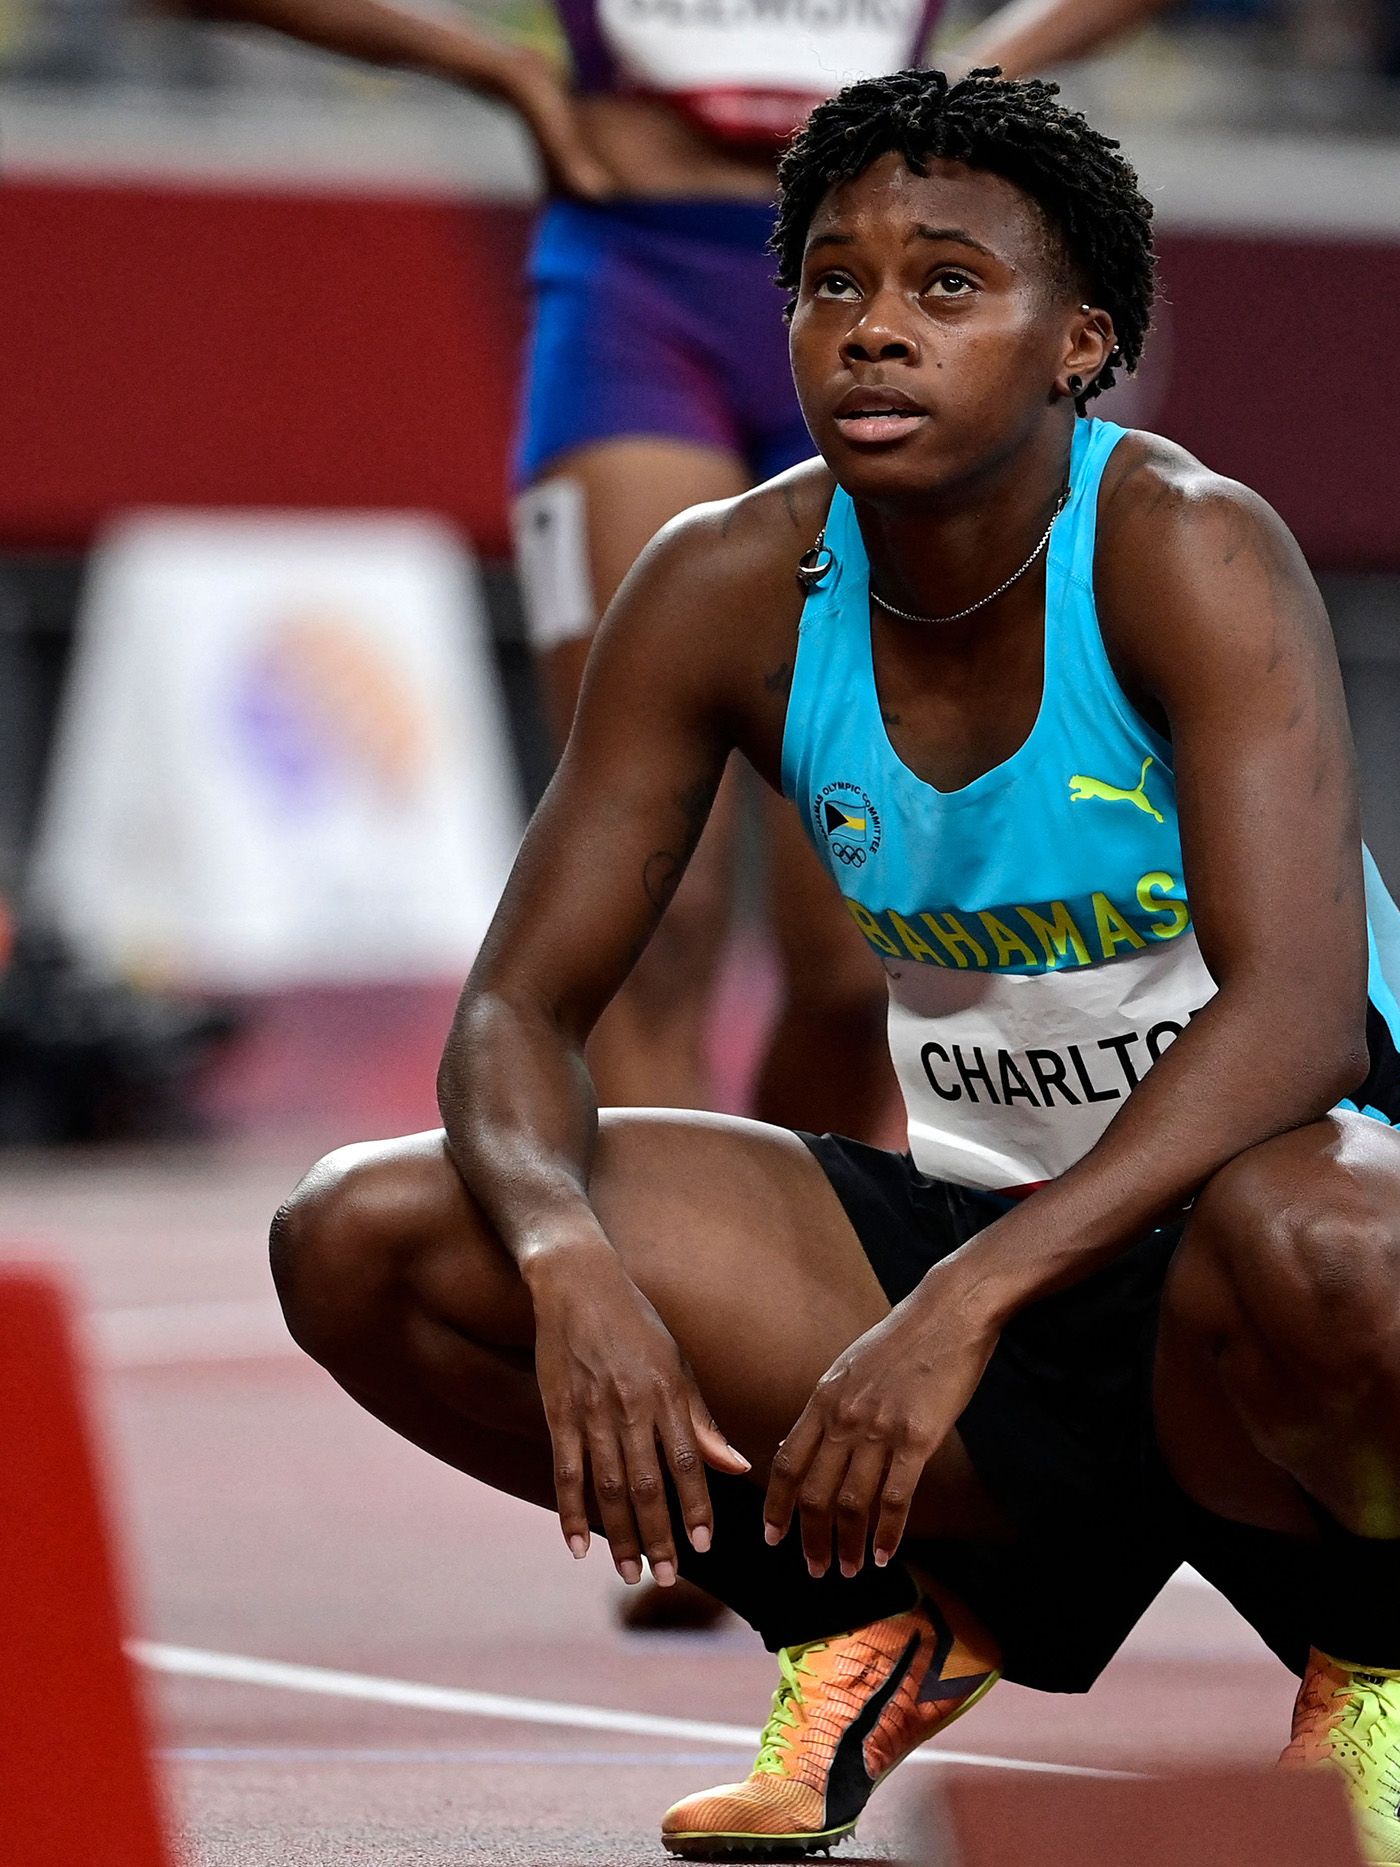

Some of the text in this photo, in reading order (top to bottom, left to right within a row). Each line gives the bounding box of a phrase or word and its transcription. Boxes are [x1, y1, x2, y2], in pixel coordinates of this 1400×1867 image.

[822, 781, 862, 796] OLYMPIC
[862, 793, 881, 854] COMMITTEE
[847, 871, 1189, 968] BAHAMAS
[920, 1006, 1203, 1108] CHARLTO
